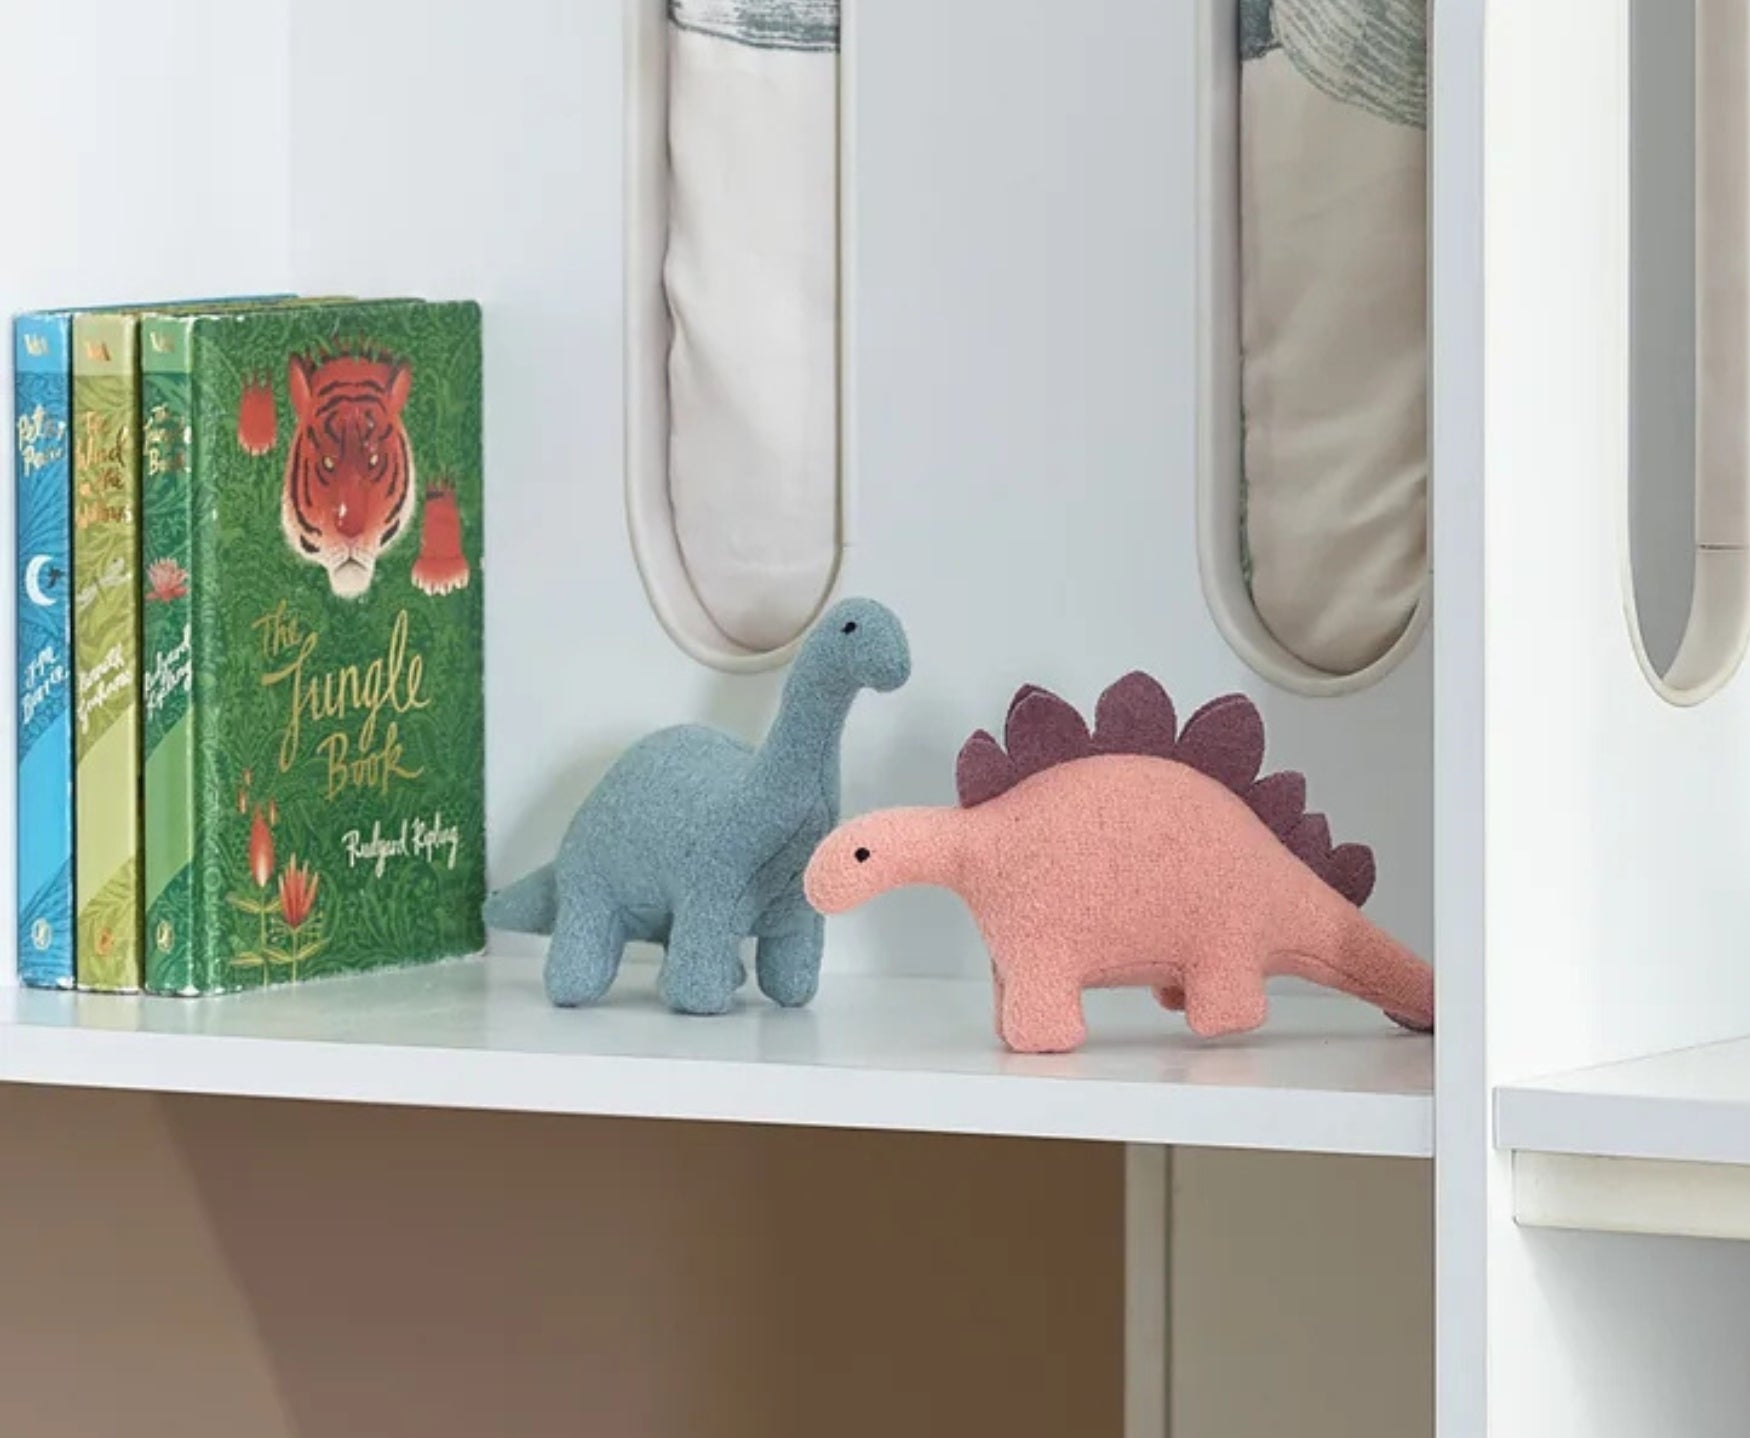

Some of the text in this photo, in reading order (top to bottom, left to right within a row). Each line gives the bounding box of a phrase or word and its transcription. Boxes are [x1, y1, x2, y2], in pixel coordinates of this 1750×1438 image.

[252, 599, 301, 656] The
[261, 609, 432, 774] Jungle
[317, 722, 425, 801] Book
